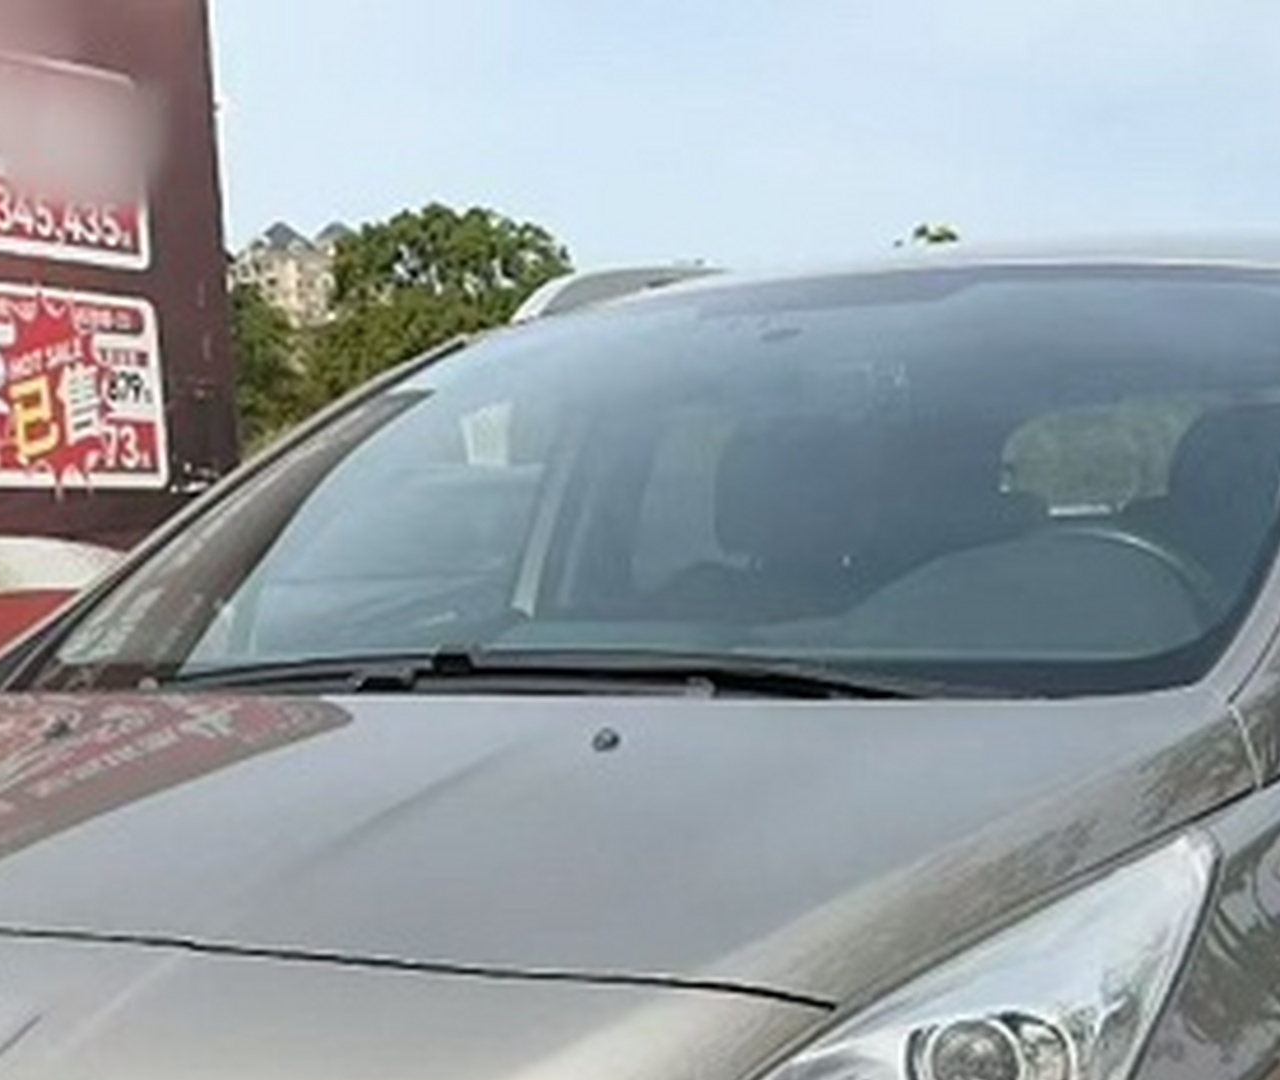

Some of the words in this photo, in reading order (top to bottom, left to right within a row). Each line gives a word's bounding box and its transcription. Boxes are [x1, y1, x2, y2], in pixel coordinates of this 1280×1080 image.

[8, 349, 42, 381] HOT
[45, 338, 83, 370] SALE
[9, 361, 102, 466] 已售
